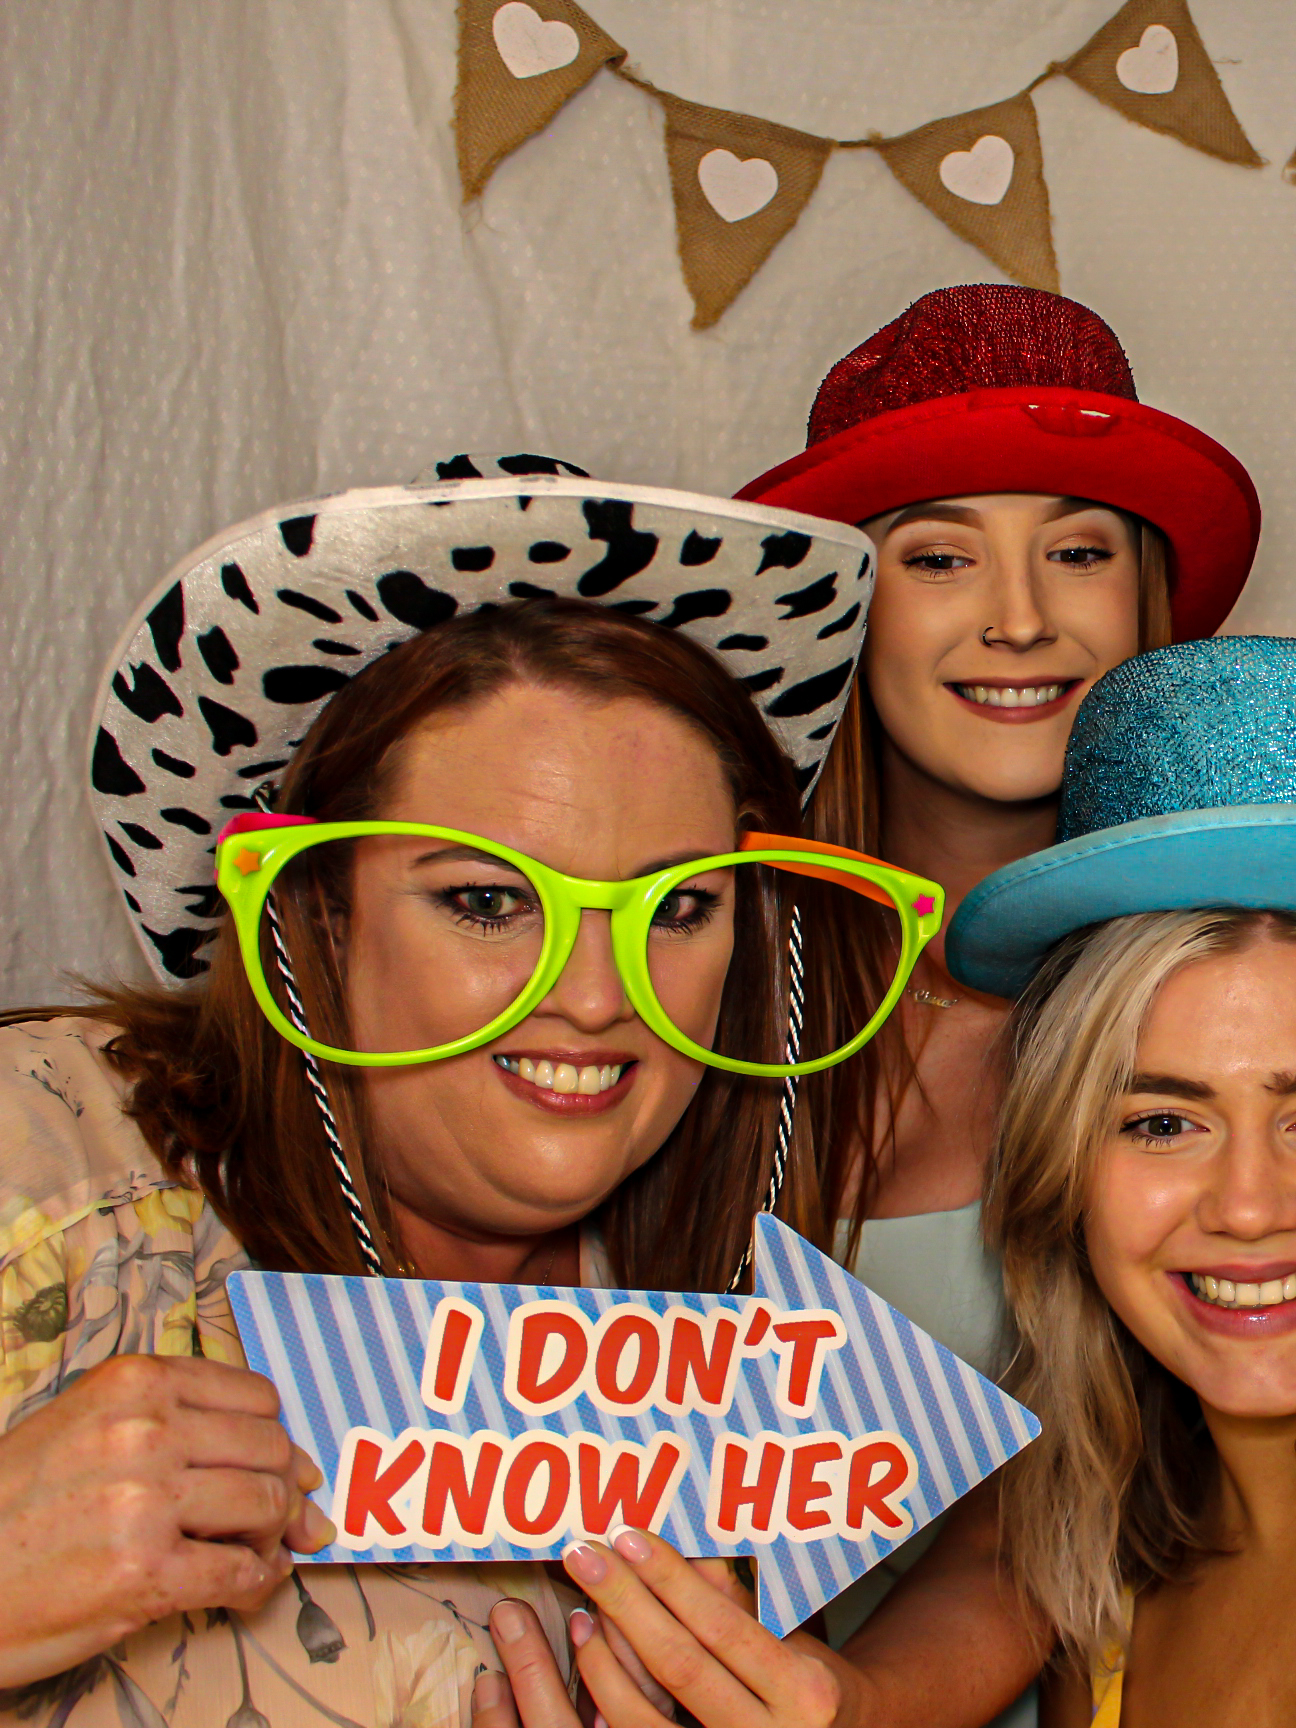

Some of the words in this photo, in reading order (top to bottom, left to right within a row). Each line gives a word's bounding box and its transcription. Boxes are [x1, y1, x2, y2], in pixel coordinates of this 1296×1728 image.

[432, 1305, 477, 1405] I
[515, 1305, 839, 1409] DON'T
[343, 1438, 682, 1538] KNOW
[715, 1439, 911, 1534] HER
